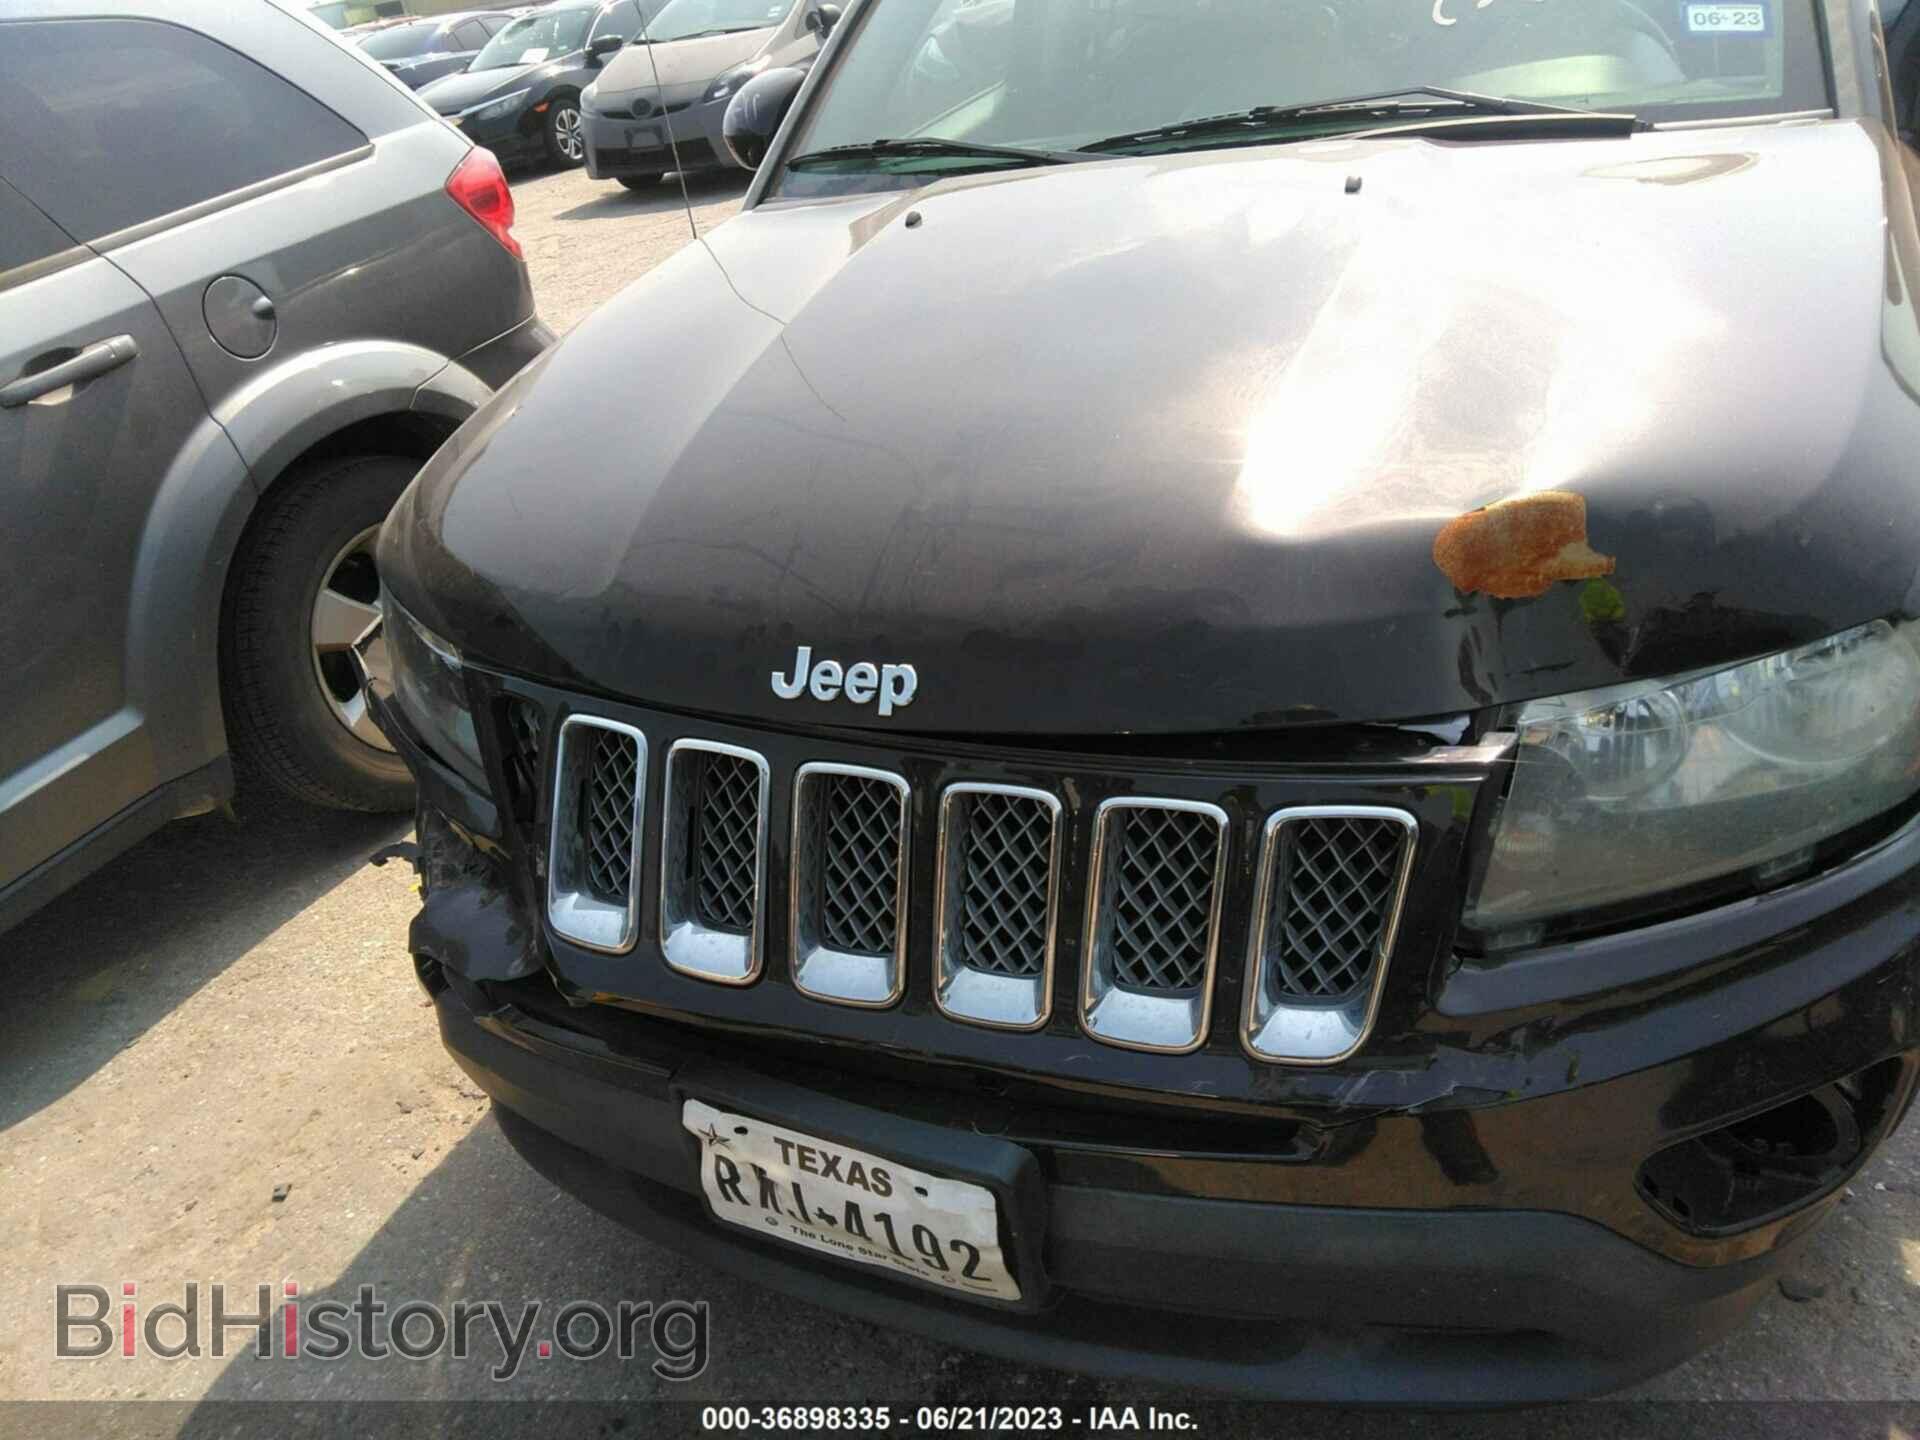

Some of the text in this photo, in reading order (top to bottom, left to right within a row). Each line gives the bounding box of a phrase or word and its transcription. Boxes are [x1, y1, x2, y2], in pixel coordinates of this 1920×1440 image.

[771, 645, 918, 716] Jeep
[773, 1136, 894, 1198] TEXAS
[790, 1224, 816, 1240] The
[844, 1200, 993, 1283] 4192
